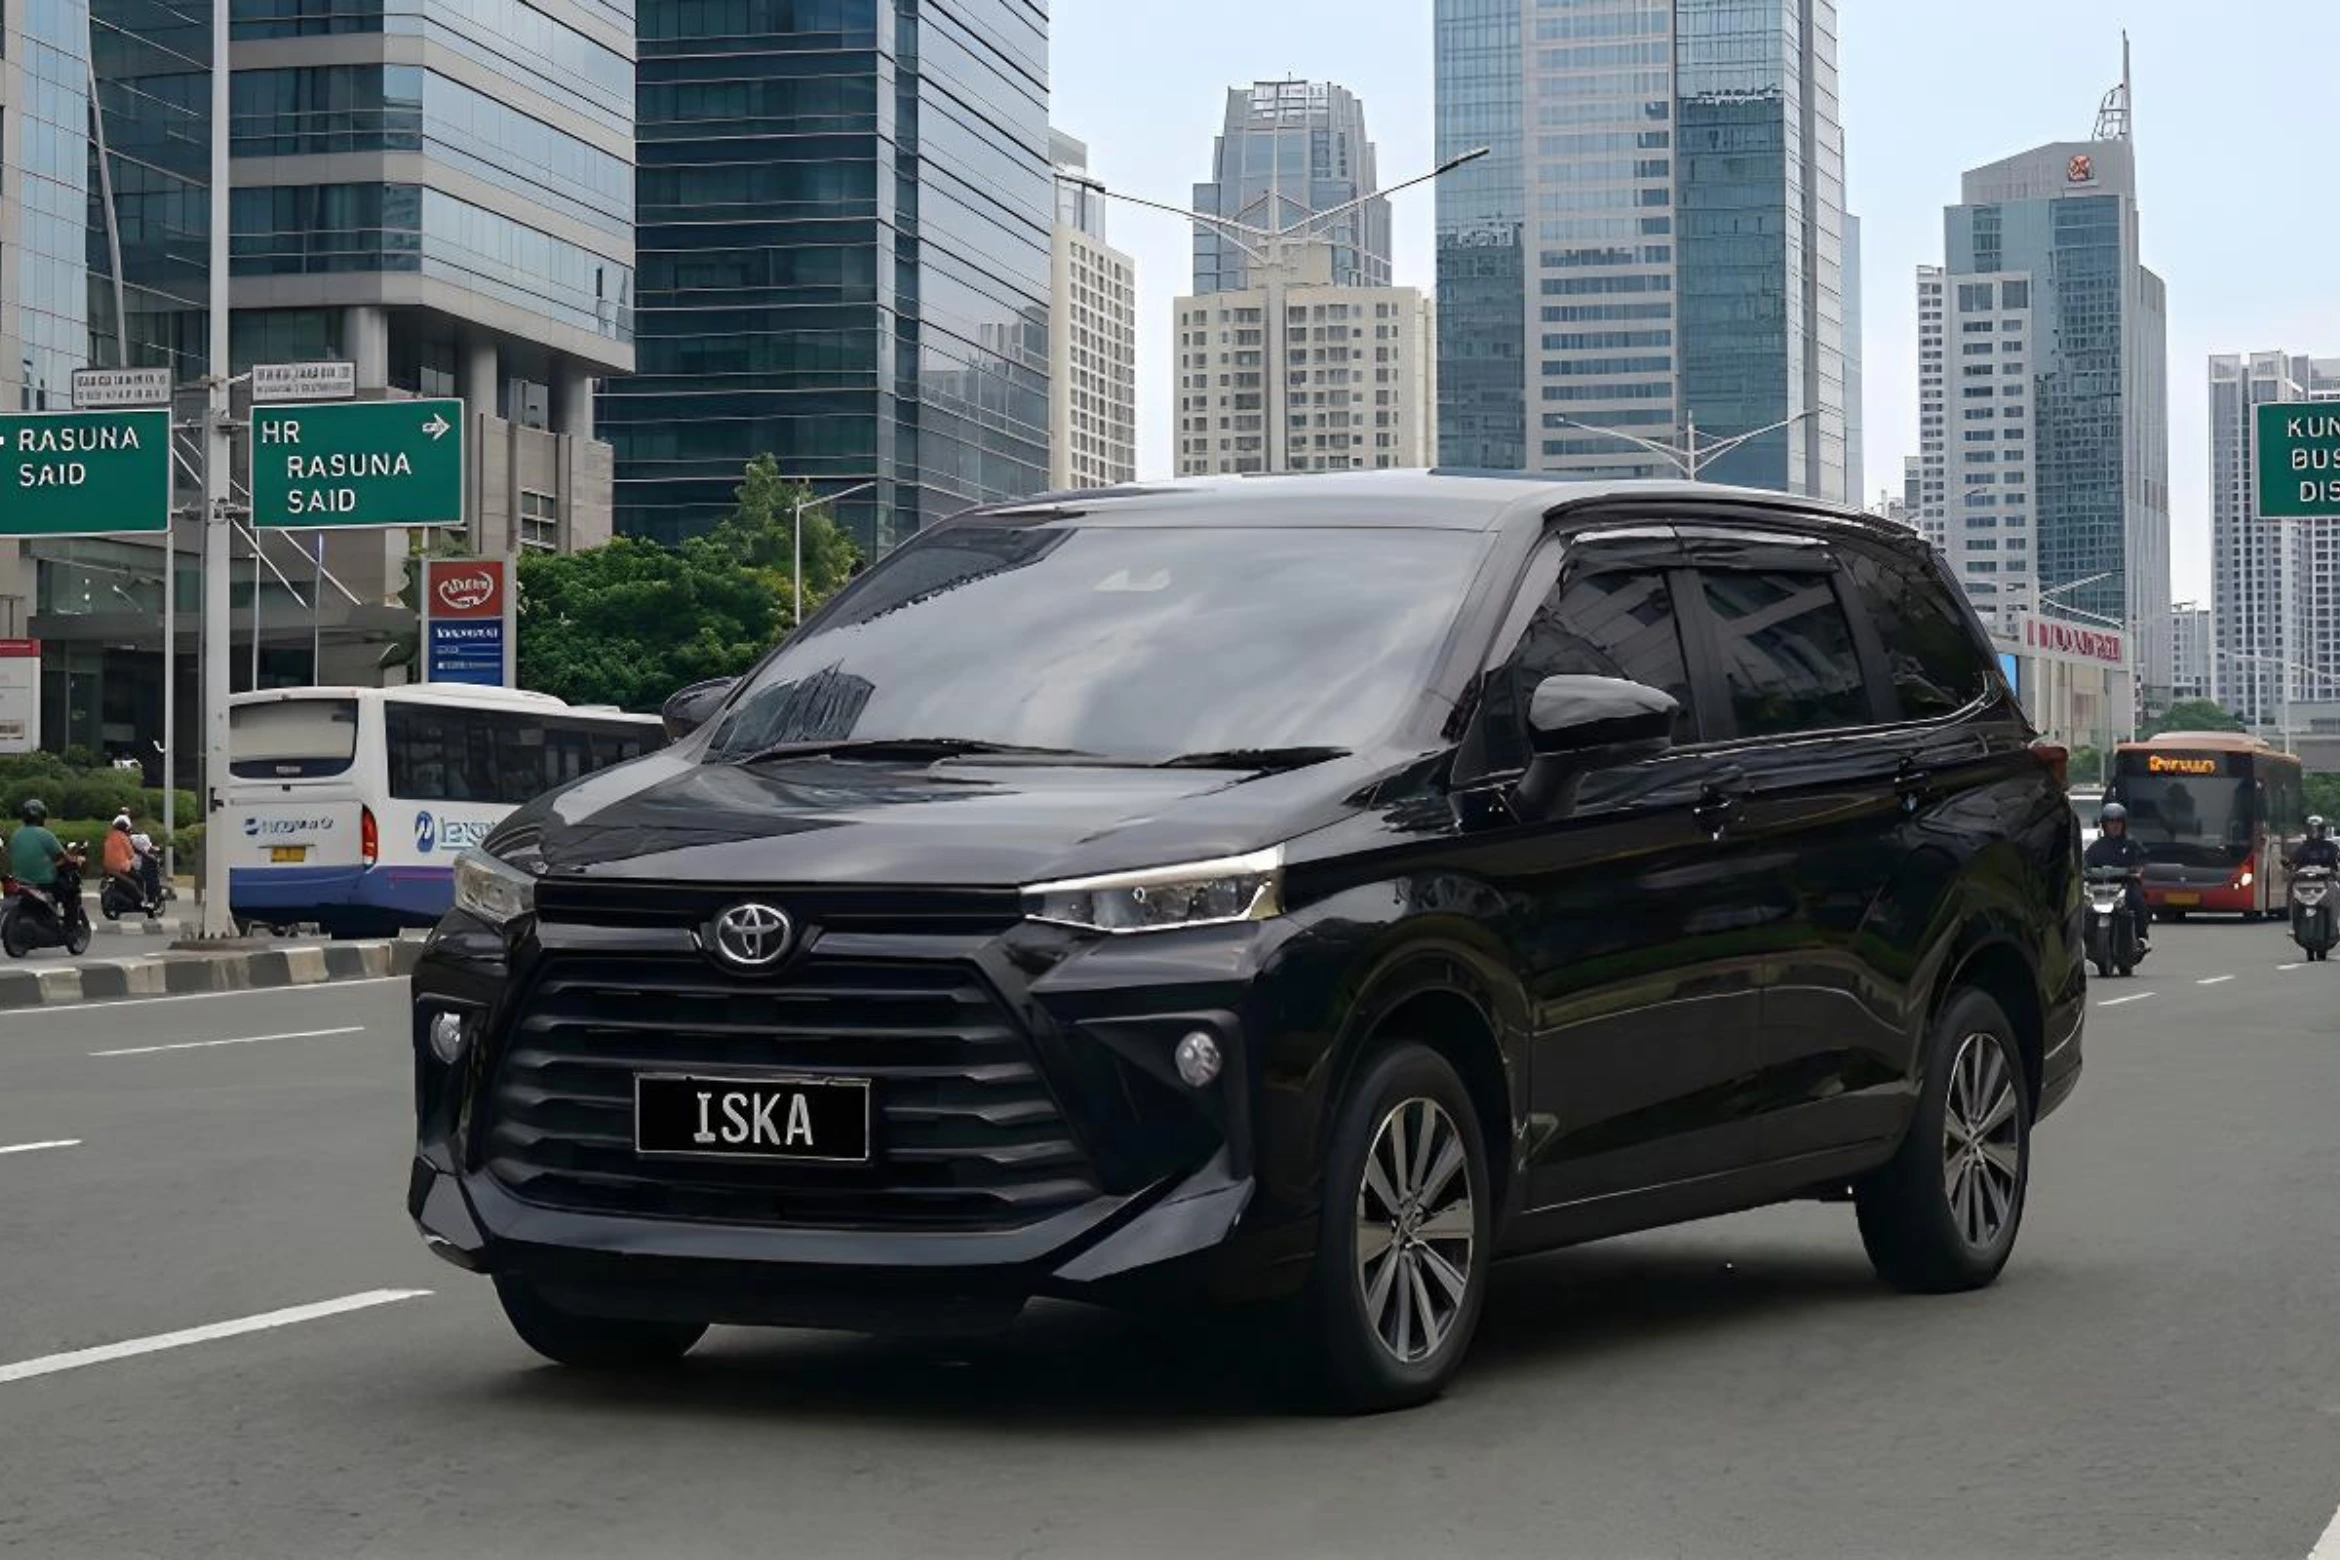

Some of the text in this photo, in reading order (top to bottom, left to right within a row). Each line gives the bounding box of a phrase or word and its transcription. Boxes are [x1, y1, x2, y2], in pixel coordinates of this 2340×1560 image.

[18, 426, 140, 452] RASUNA
[261, 420, 300, 444] HR
[19, 463, 86, 487] SAID
[287, 452, 412, 479] RASUNA
[287, 488, 355, 514] SAID
[2300, 480, 2340, 502] DIS
[693, 1091, 814, 1146] ISKA
